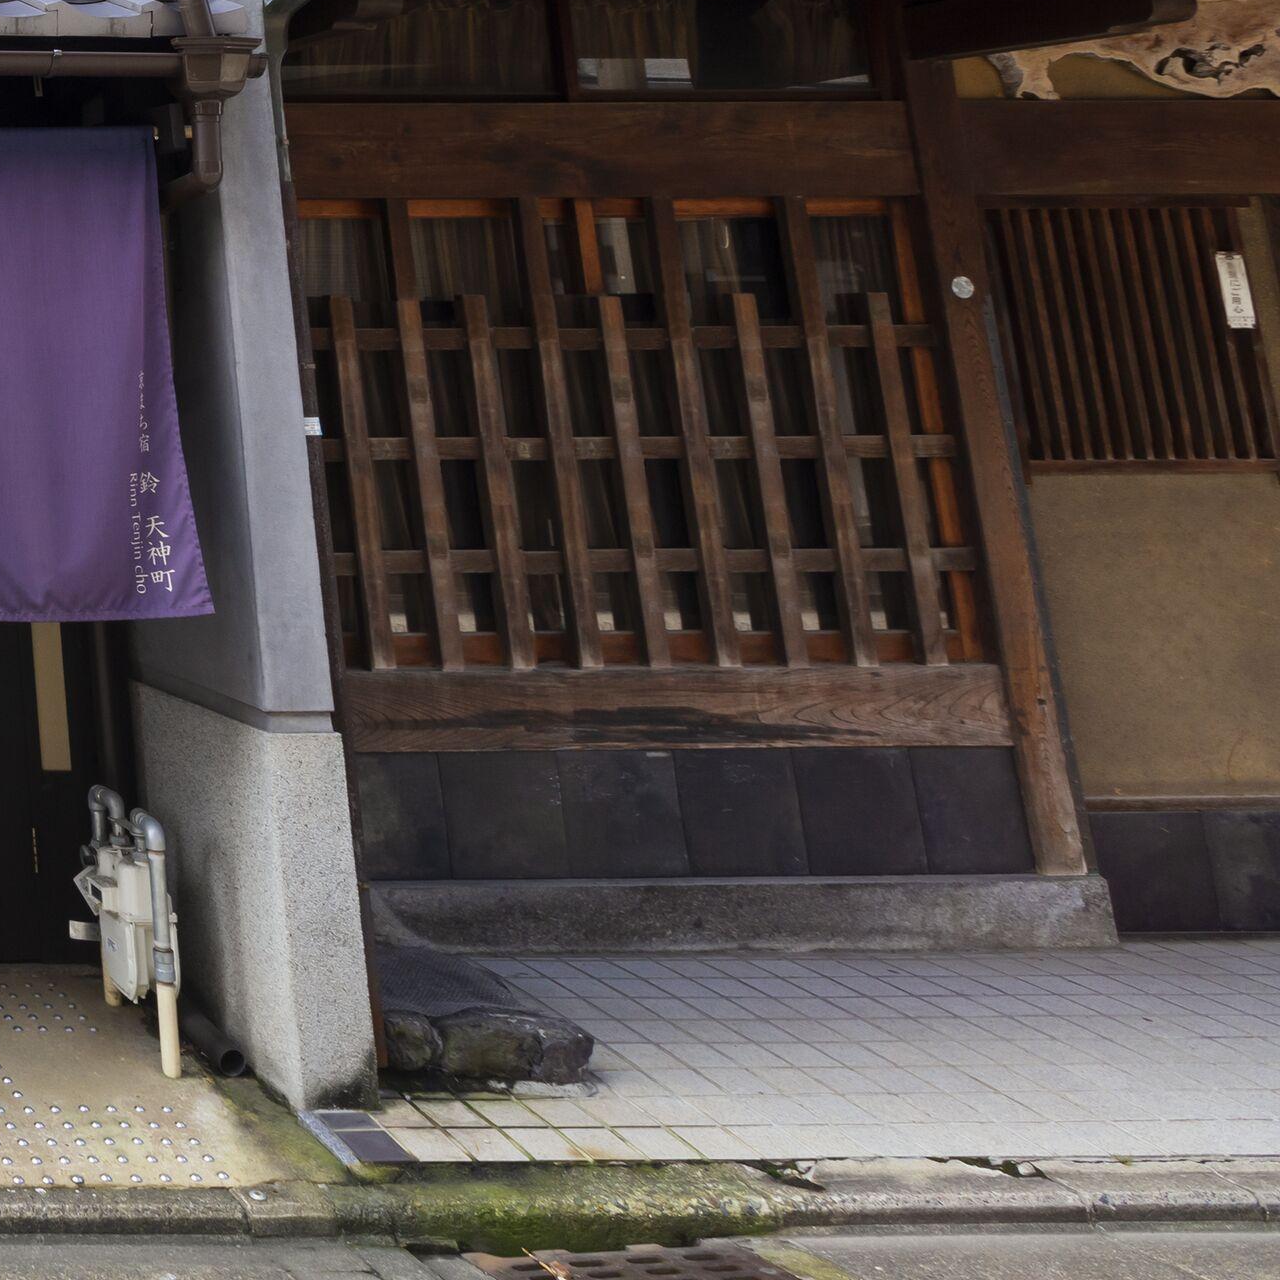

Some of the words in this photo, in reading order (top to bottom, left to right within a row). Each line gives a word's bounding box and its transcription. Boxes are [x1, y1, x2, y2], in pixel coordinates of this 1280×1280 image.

[130, 472, 138, 508] Rinn
[140, 471, 161, 494] 鈴
[131, 512, 144, 561] Tenjin
[145, 515, 177, 593] 天神町
[134, 565, 149, 595] cho
